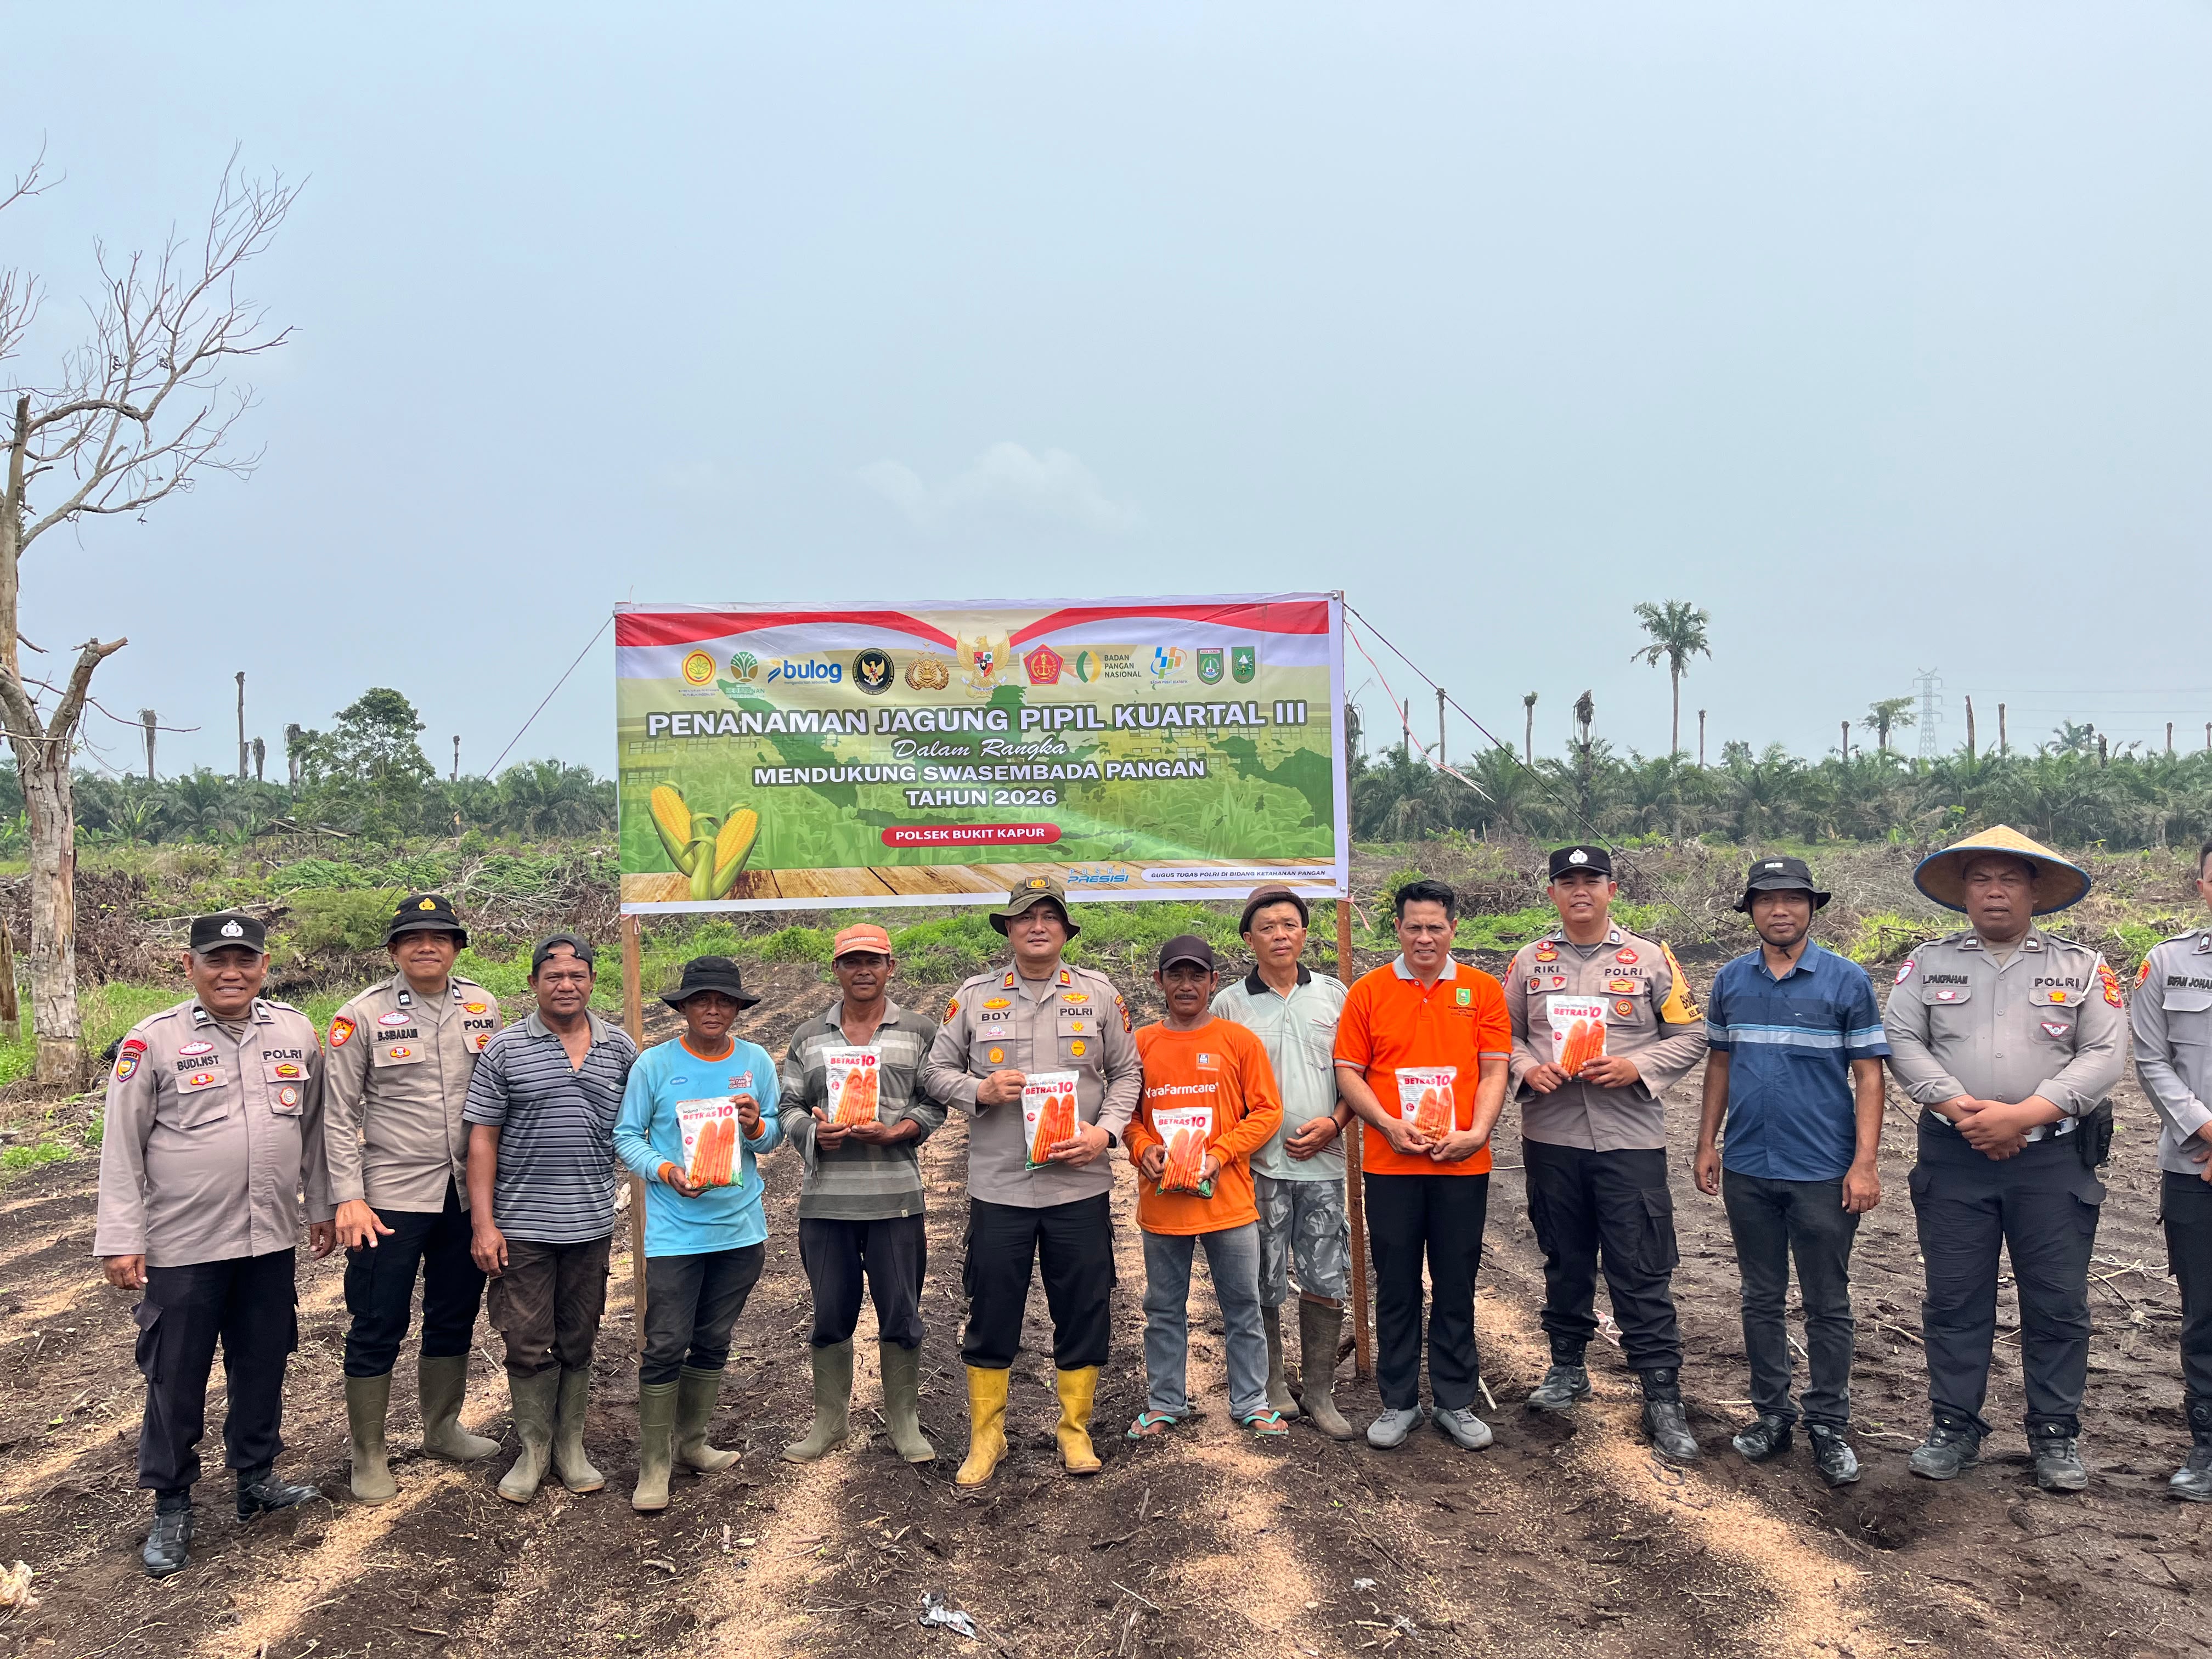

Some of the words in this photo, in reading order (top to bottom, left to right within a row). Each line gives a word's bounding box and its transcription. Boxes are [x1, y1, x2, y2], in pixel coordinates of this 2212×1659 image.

[783, 659, 842, 684] bulog
[648, 712, 866, 736] PENANAMAN
[877, 709, 1008, 732] JAGUNG
[1020, 707, 1105, 730] PIPIL
[1115, 704, 1266, 727] KUARTAL
[1276, 702, 1305, 724] III
[894, 738, 972, 758] Dalam
[981, 737, 1067, 761] Rangka
[754, 766, 916, 785] MENDUKUNG
[923, 763, 1099, 781] SWASEMBADA
[1107, 760, 1205, 778] PANGAN
[906, 789, 986, 806] TAHUN
[994, 789, 1057, 805] 2026
[896, 831, 949, 840] POLSEK
[952, 829, 994, 839] BUKIT
[997, 828, 1045, 838] KAPUR
[1534, 965, 1560, 974] RIKI
[1605, 968, 1643, 977] POLRI
[2035, 978, 2079, 988] POLRI
[981, 1011, 1012, 1022] BOY
[1059, 1008, 1093, 1016] POLRI
[1554, 1008, 1588, 1016] BETRAS
[1589, 1006, 1601, 1018] 10
[464, 1019, 494, 1030] POLRI
[263, 1049, 302, 1060] POLRI
[861, 1054, 876, 1066] 10
[177, 1054, 219, 1071] BUDI.NST
[1435, 1075, 1450, 1087] 10
[1025, 1086, 1057, 1095] BETRAS
[1058, 1081, 1074, 1093] 10
[682, 1111, 716, 1120] BETRAS
[717, 1105, 733, 1118] 10
[1190, 1116, 1206, 1128] 10
